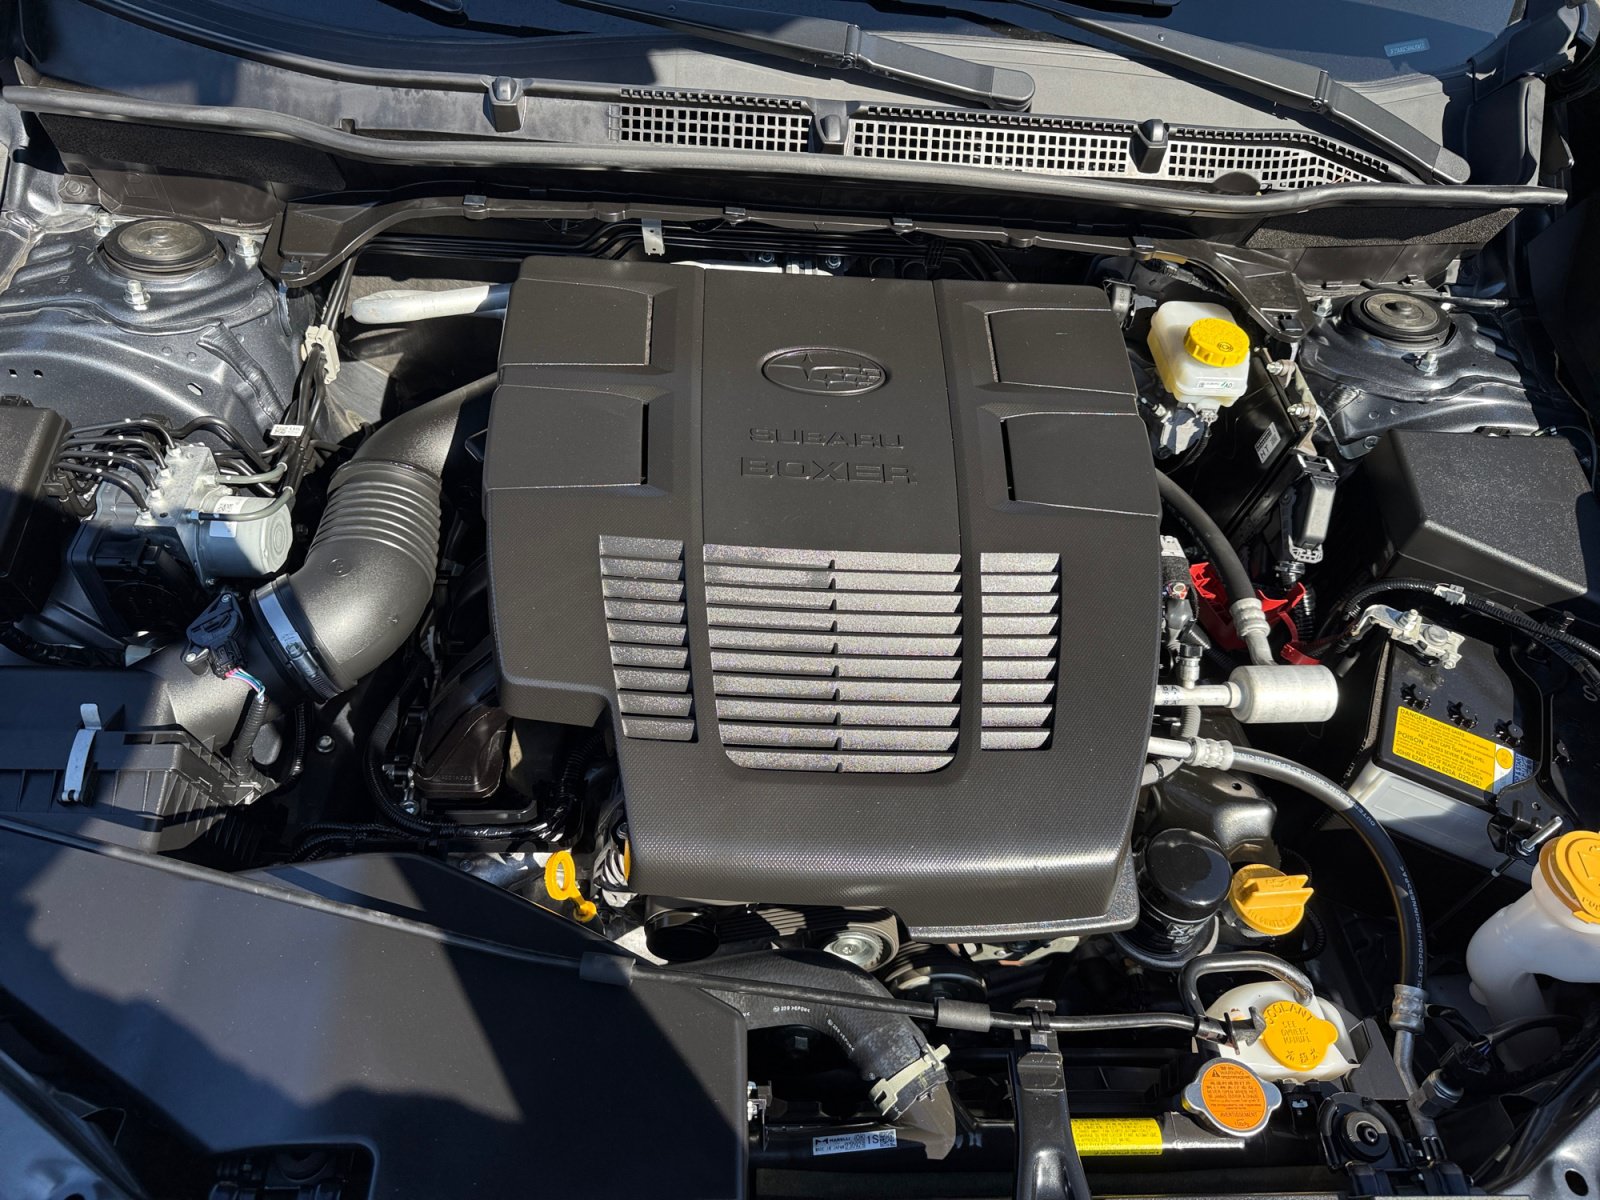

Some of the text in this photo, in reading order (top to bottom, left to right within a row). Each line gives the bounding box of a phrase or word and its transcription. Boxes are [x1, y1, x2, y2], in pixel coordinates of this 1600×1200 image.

[750, 428, 904, 449] SUBARU
[740, 457, 917, 484] BOXER
[1400, 708, 1464, 737] DANGER EXPLOSIVE GASES
[1397, 730, 1474, 765] POISON CAUSES SEVERE BURNS
[1418, 733, 1428, 741] KEEP
[1451, 746, 1463, 754] TIGHT
[1415, 750, 1426, 758] KEEP
[1441, 761, 1457, 770] REACH
[1462, 769, 1483, 780] CHILDREN
[1428, 761, 1441, 770] CCA
[1264, 1002, 1313, 1024] COOLANT
[1282, 1020, 1297, 1028] SEE
[1283, 1035, 1312, 1044] MANUAL
